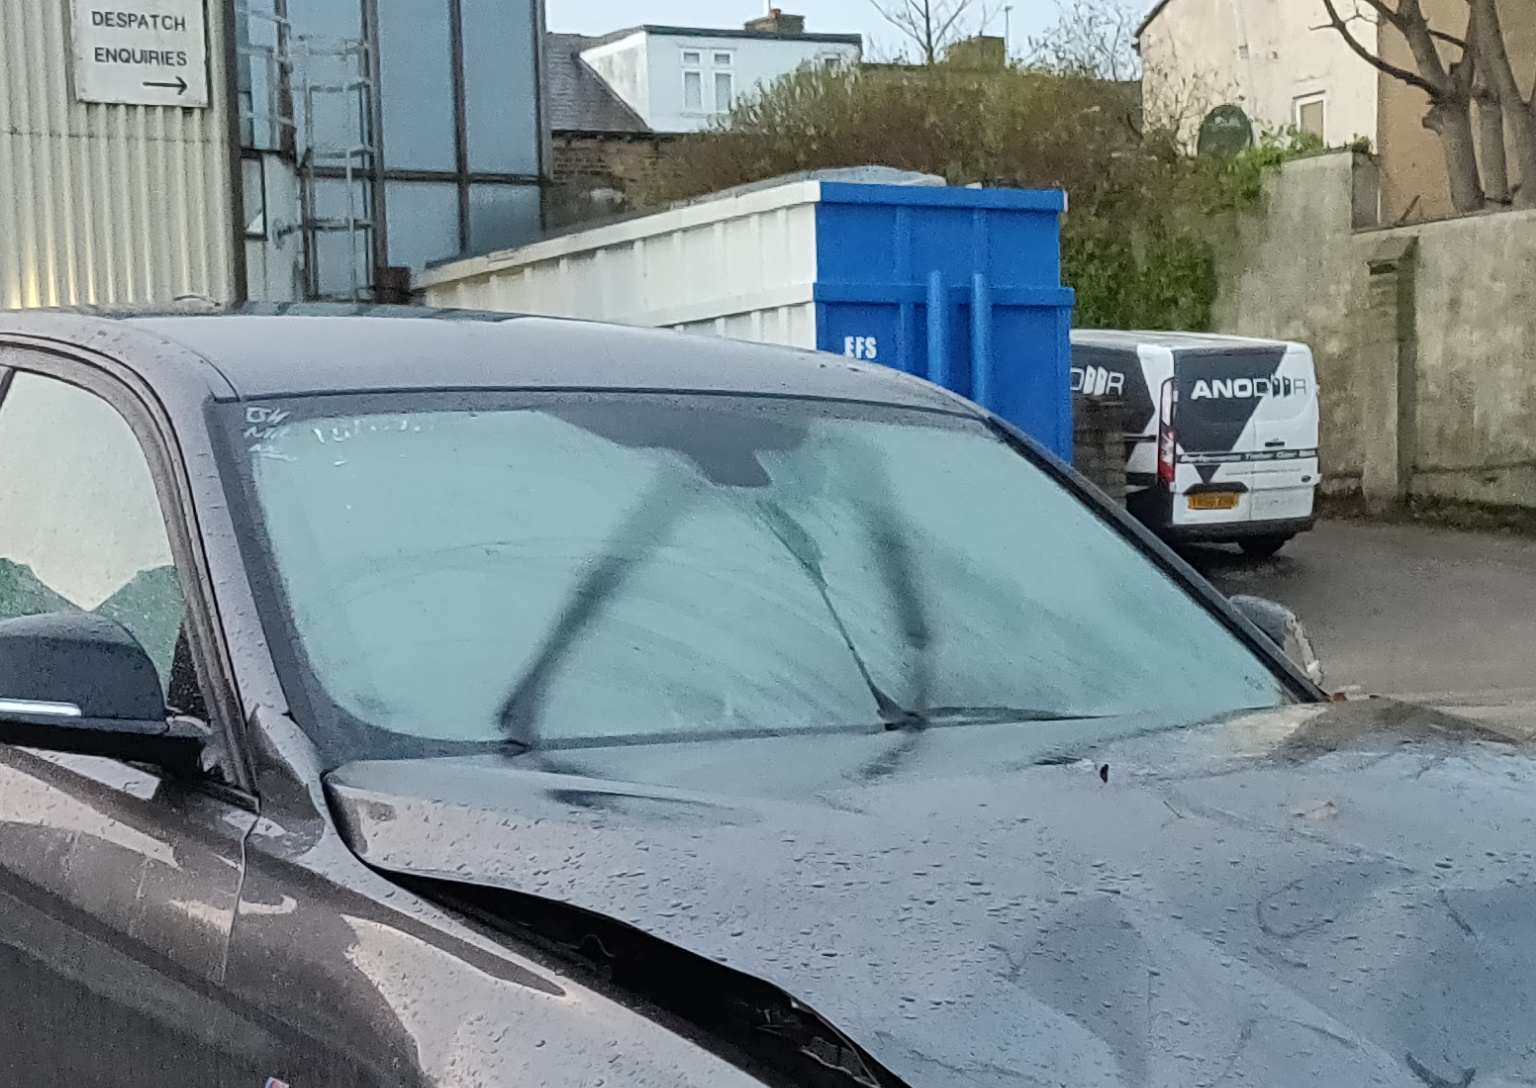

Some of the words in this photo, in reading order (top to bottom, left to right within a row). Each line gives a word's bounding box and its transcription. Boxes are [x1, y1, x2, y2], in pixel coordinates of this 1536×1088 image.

[91, 10, 186, 32] DESPATCH
[94, 46, 187, 67] ENQUIRIES
[844, 335, 877, 359] EFS
